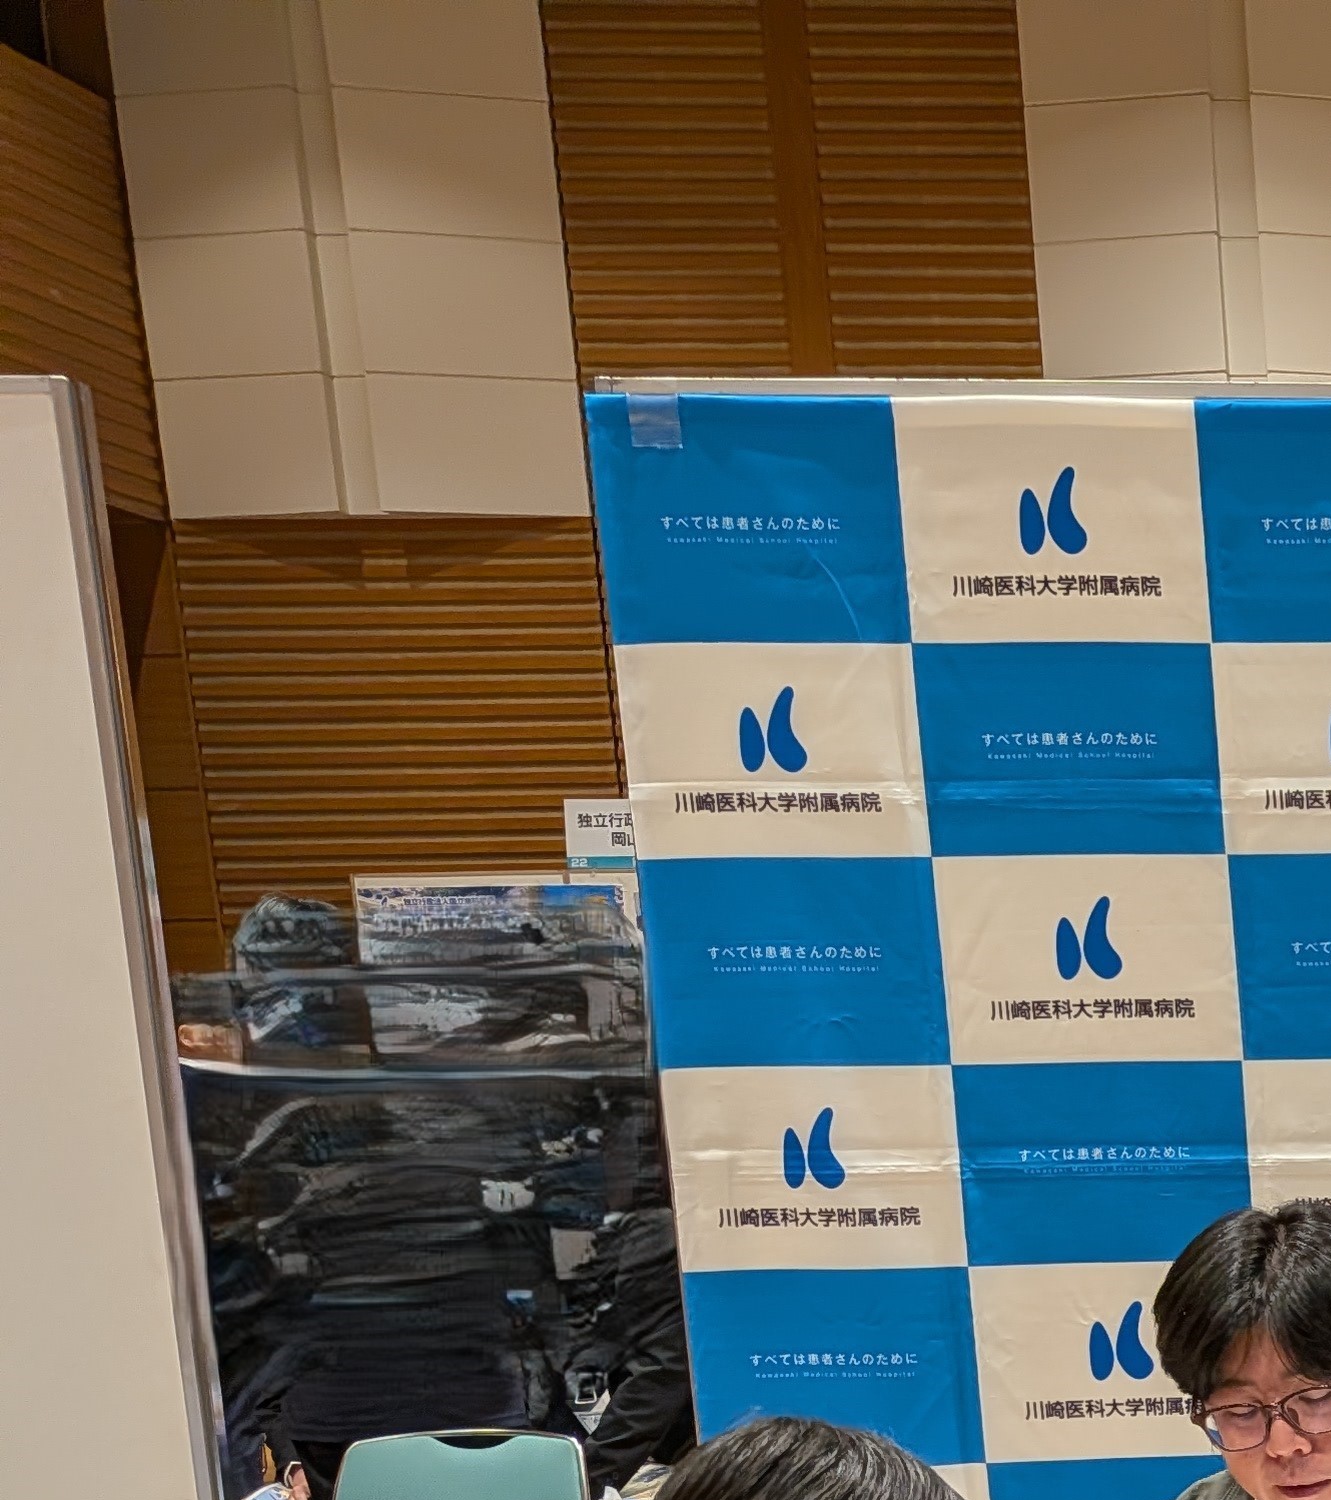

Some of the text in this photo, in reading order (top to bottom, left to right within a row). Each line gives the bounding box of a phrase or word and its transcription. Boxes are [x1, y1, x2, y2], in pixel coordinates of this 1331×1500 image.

[660, 516, 840, 531] すべては患者さんのために
[952, 575, 1162, 598] 川崎医科大学附属病院
[982, 732, 1158, 747] すべては患者さんのために
[674, 792, 882, 815] 川崎医科大学附属病院
[571, 858, 588, 868] 22
[707, 945, 882, 960] すべては患者さんのために
[990, 998, 1196, 1022] 川崎医科大学附属病院
[1018, 1146, 1191, 1162] すべては患者さんのために
[718, 1206, 921, 1230] 川崎医科大学附属病院
[749, 1353, 919, 1367] すべては患者さんのために
